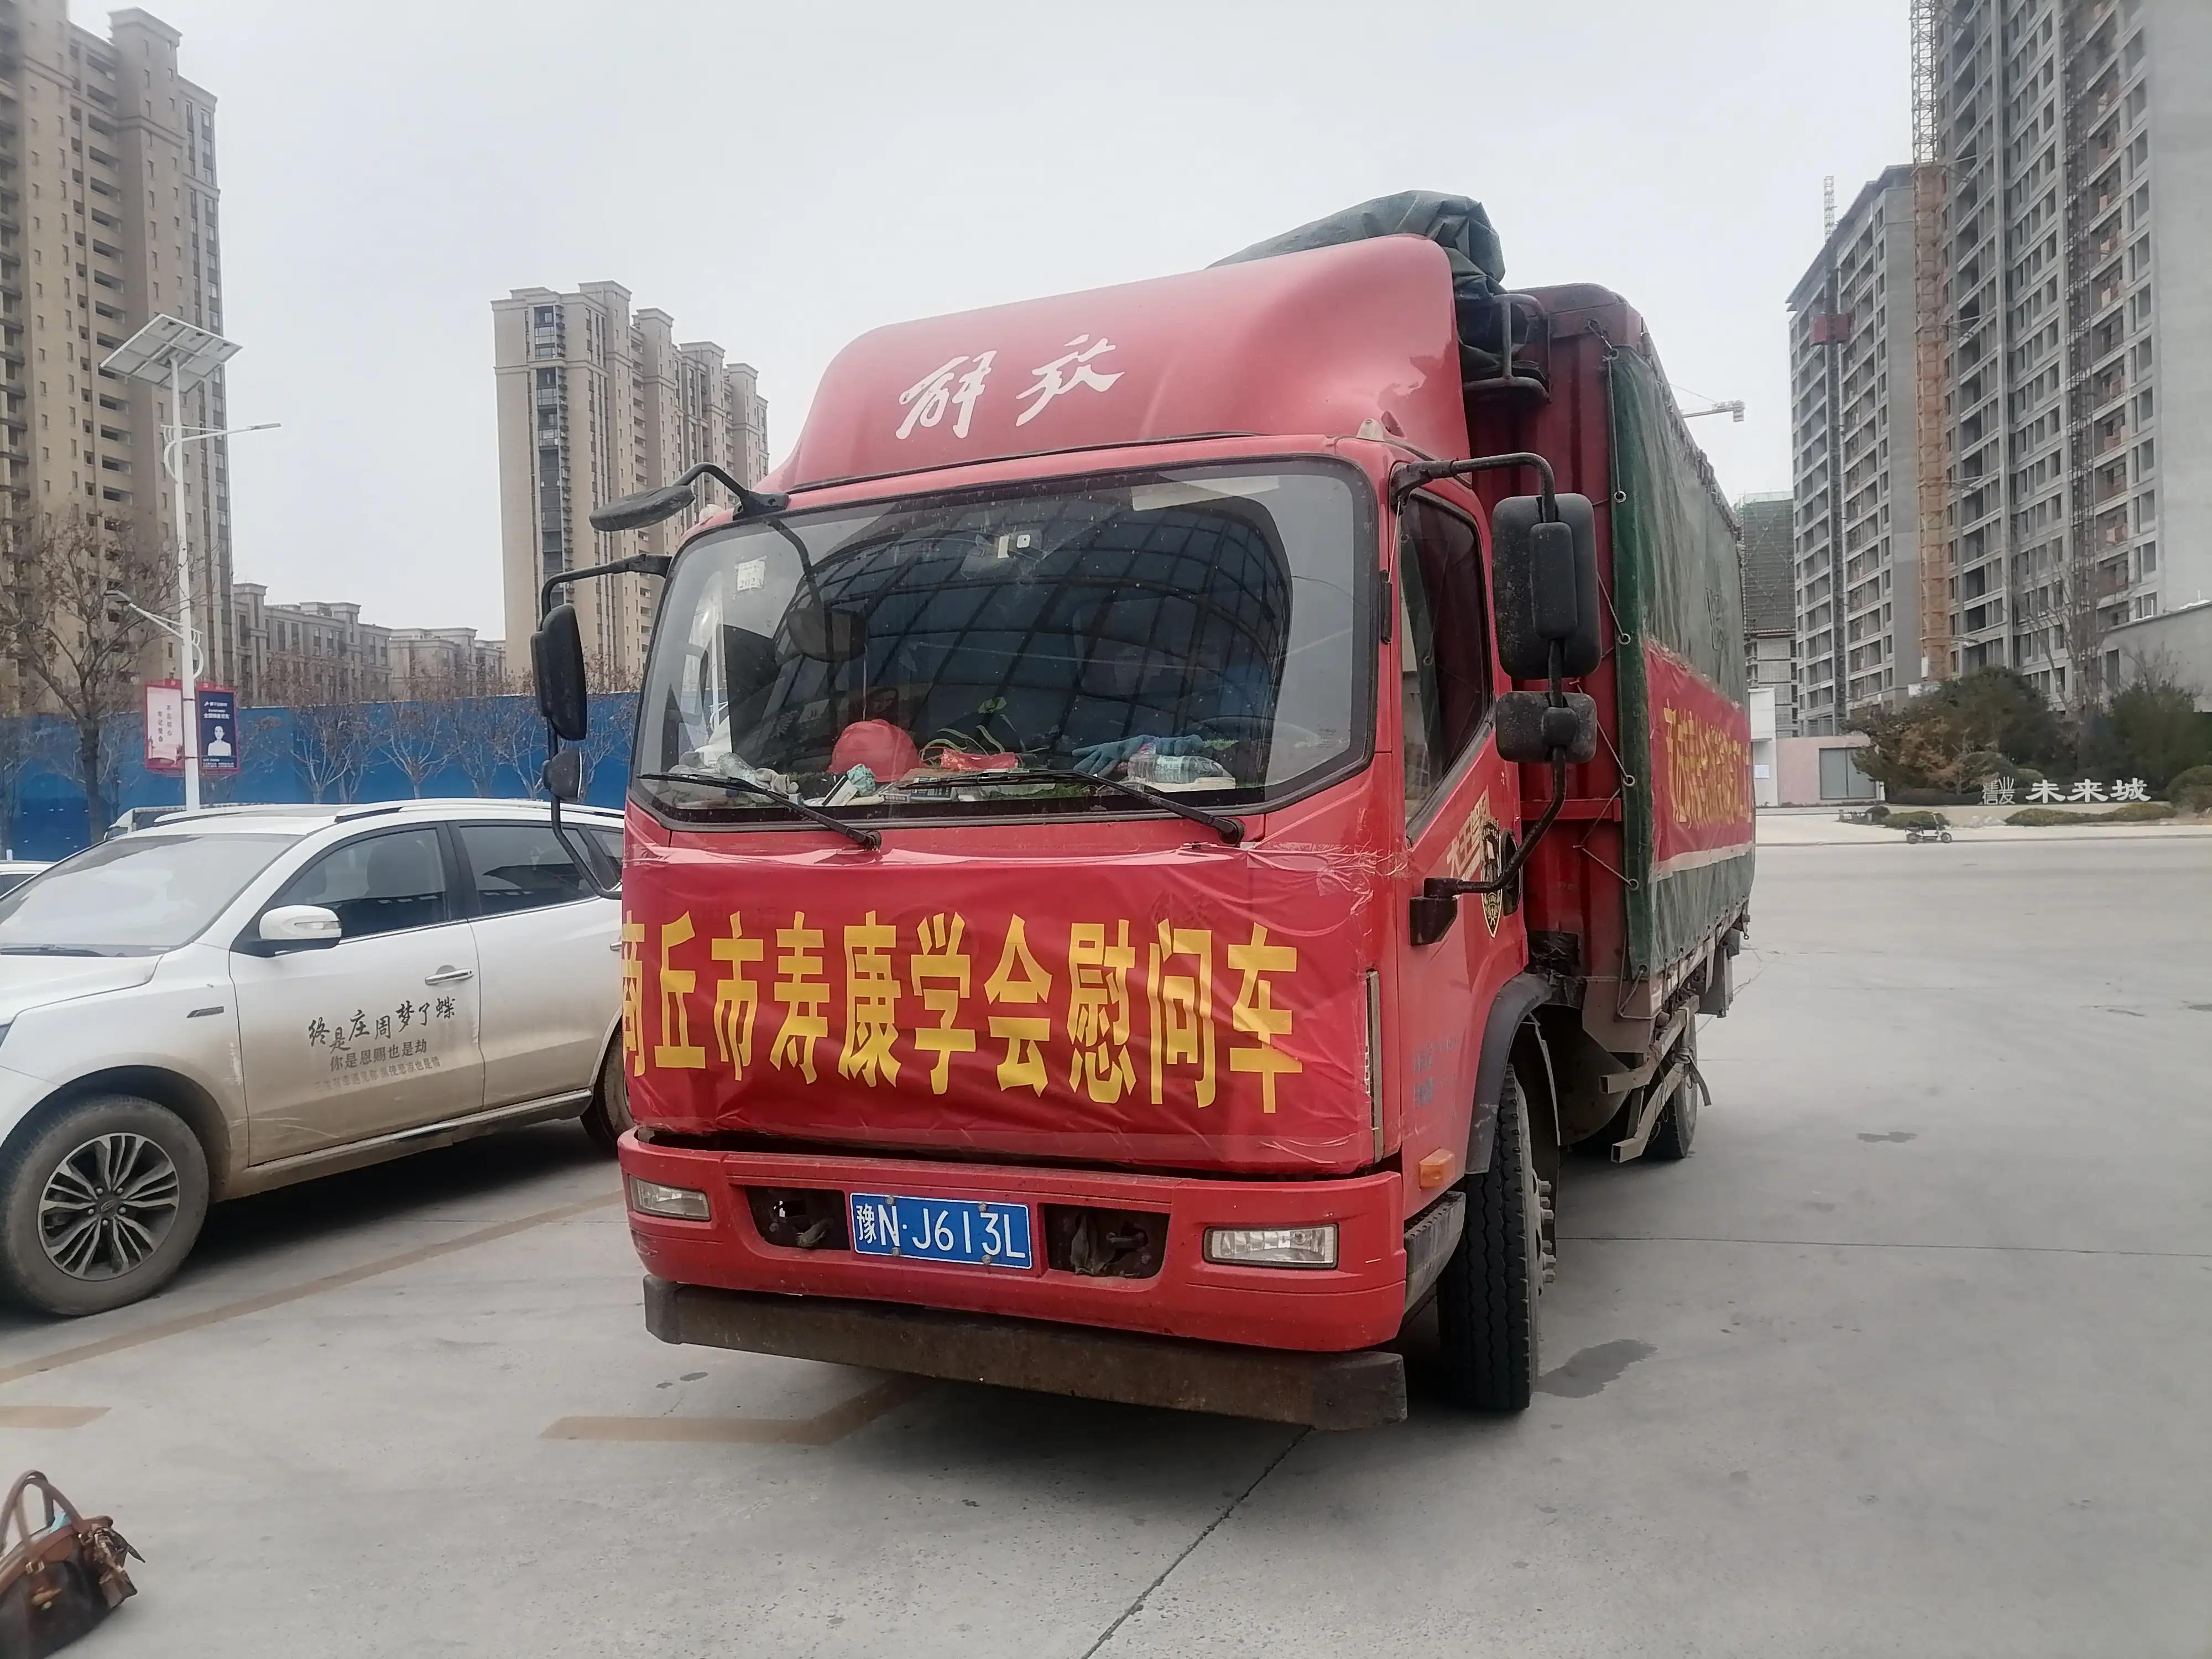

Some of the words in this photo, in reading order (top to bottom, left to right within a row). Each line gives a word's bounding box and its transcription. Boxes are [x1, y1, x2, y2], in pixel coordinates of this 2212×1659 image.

[895, 334, 1125, 440] 解放
[2025, 778, 2152, 804] 未来城
[309, 997, 456, 1054] 终是庄周梦了蝶
[330, 1039, 427, 1072] 你是恩赐也是劫
[855, 1203, 1026, 1259] 豫N·J613L
